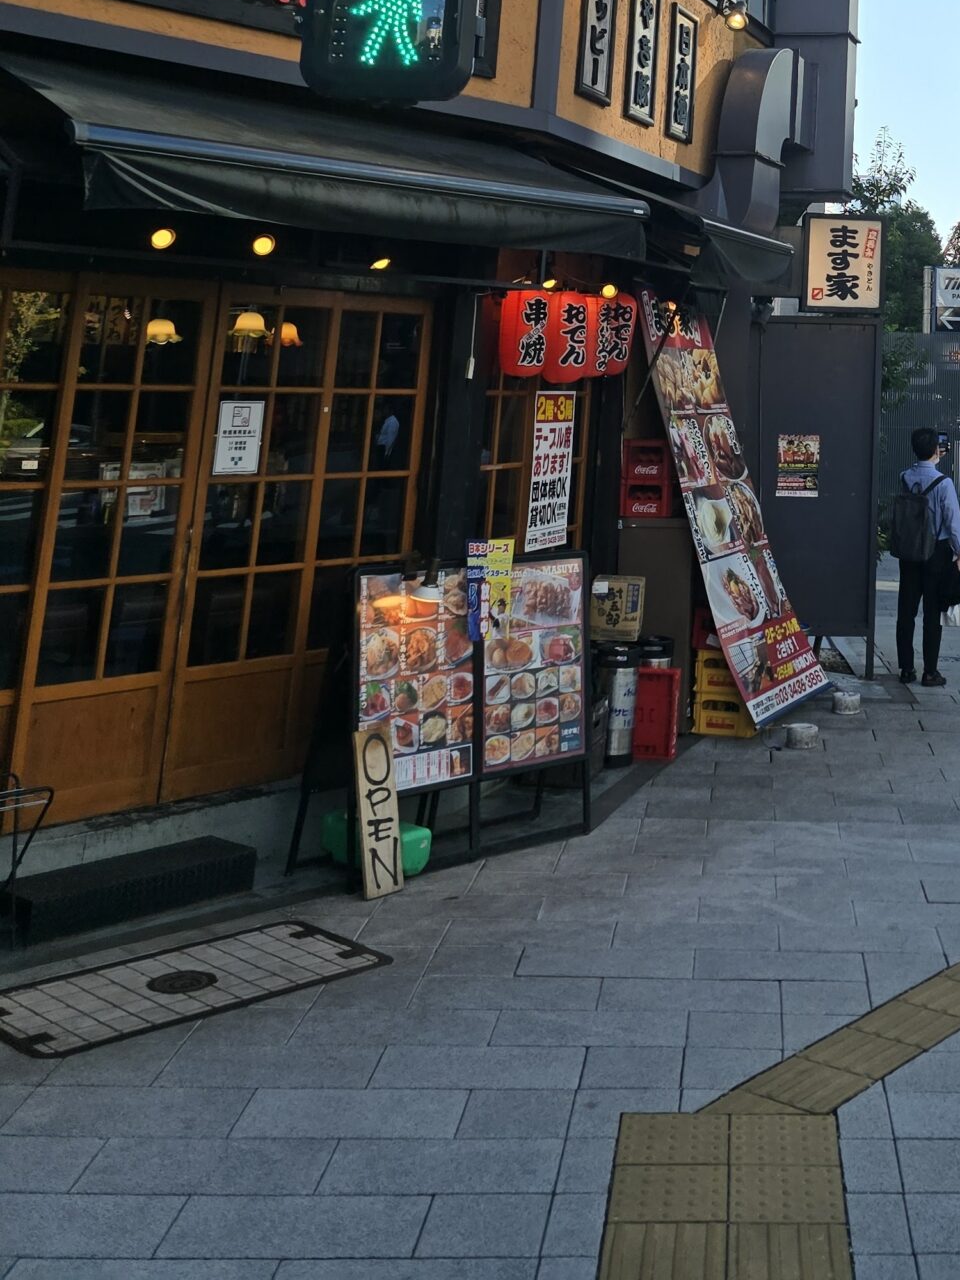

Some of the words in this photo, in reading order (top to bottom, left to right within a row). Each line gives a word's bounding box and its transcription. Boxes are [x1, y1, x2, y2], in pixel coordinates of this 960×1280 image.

[824, 225, 860, 301] ます家
[866, 262, 874, 292] やきとん
[519, 297, 547, 366] 串焼
[559, 303, 586, 367] おでん
[606, 302, 632, 361] おでん
[528, 502, 558, 528] 貸切OK
[468, 542, 510, 556] 日本シリーズ
[541, 563, 580, 574] MASUYA
[362, 733, 399, 889] OPEN
